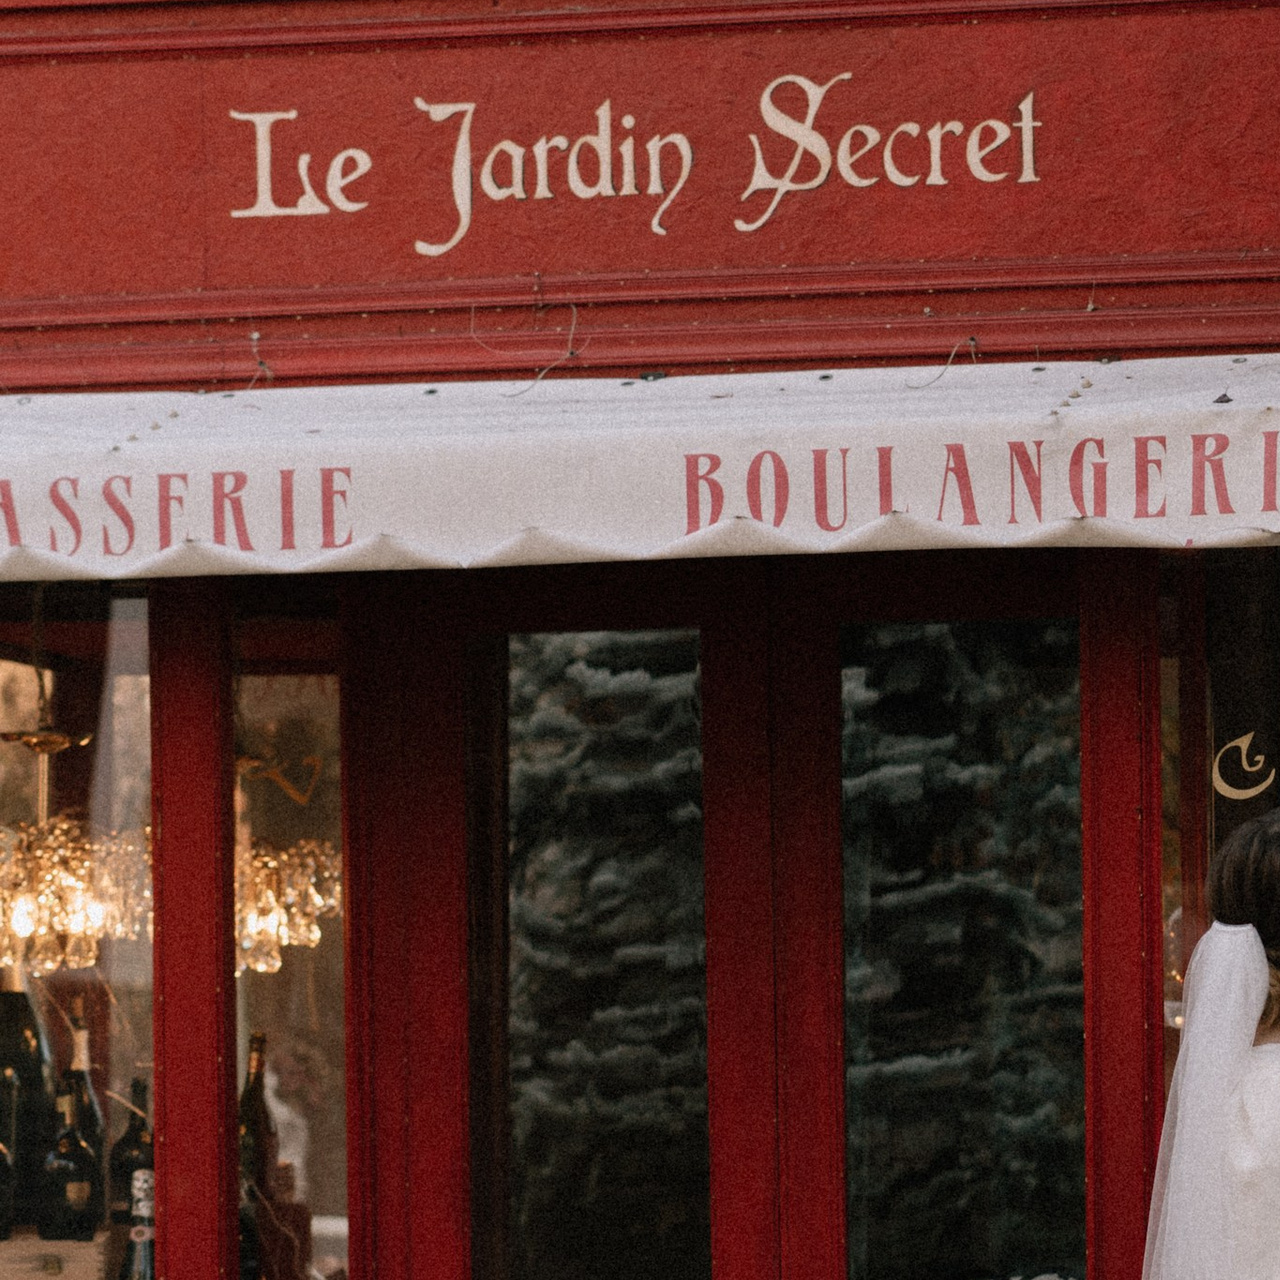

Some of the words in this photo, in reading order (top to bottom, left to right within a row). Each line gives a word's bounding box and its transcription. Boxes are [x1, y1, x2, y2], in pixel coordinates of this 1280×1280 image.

[229, 109, 373, 218] Le
[414, 95, 694, 256] Jardin
[733, 71, 1042, 232] Secret
